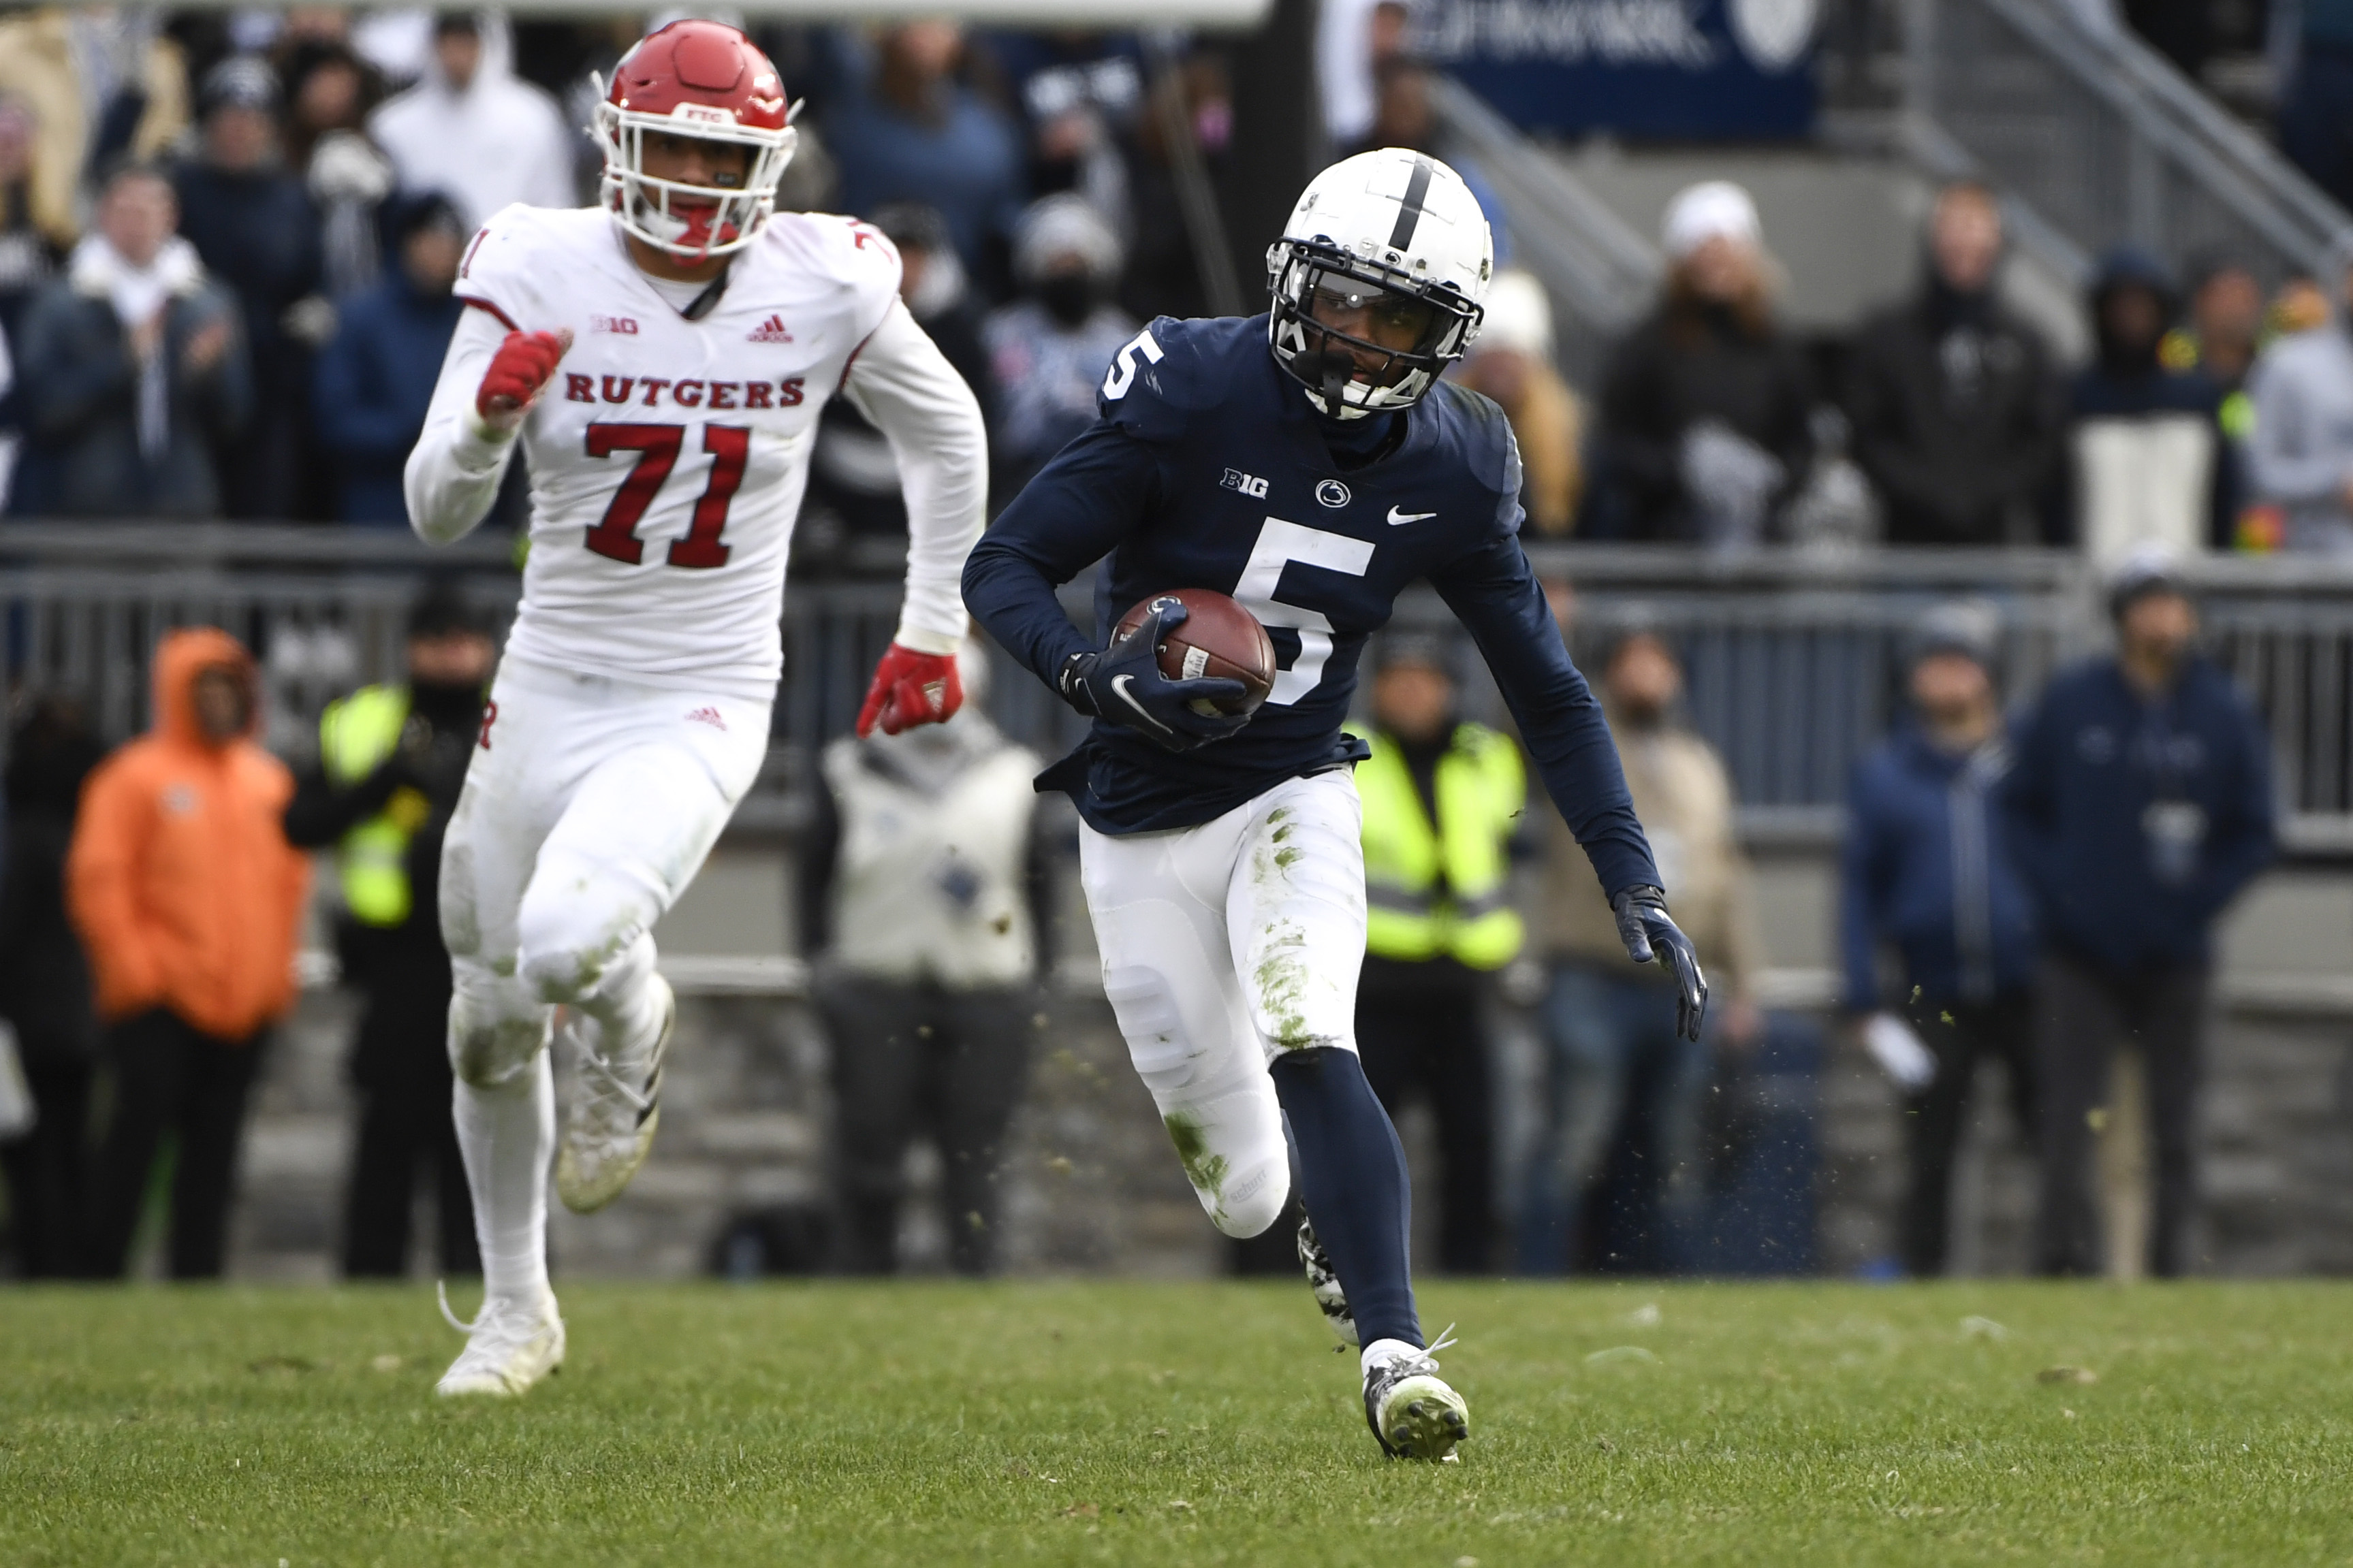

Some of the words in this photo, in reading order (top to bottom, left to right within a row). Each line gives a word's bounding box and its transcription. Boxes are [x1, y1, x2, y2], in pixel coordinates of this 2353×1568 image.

[565, 372, 805, 409] RUTGERS
[1103, 330, 1165, 400] 5
[584, 422, 753, 569] 71
[1232, 515, 1376, 706] 5
